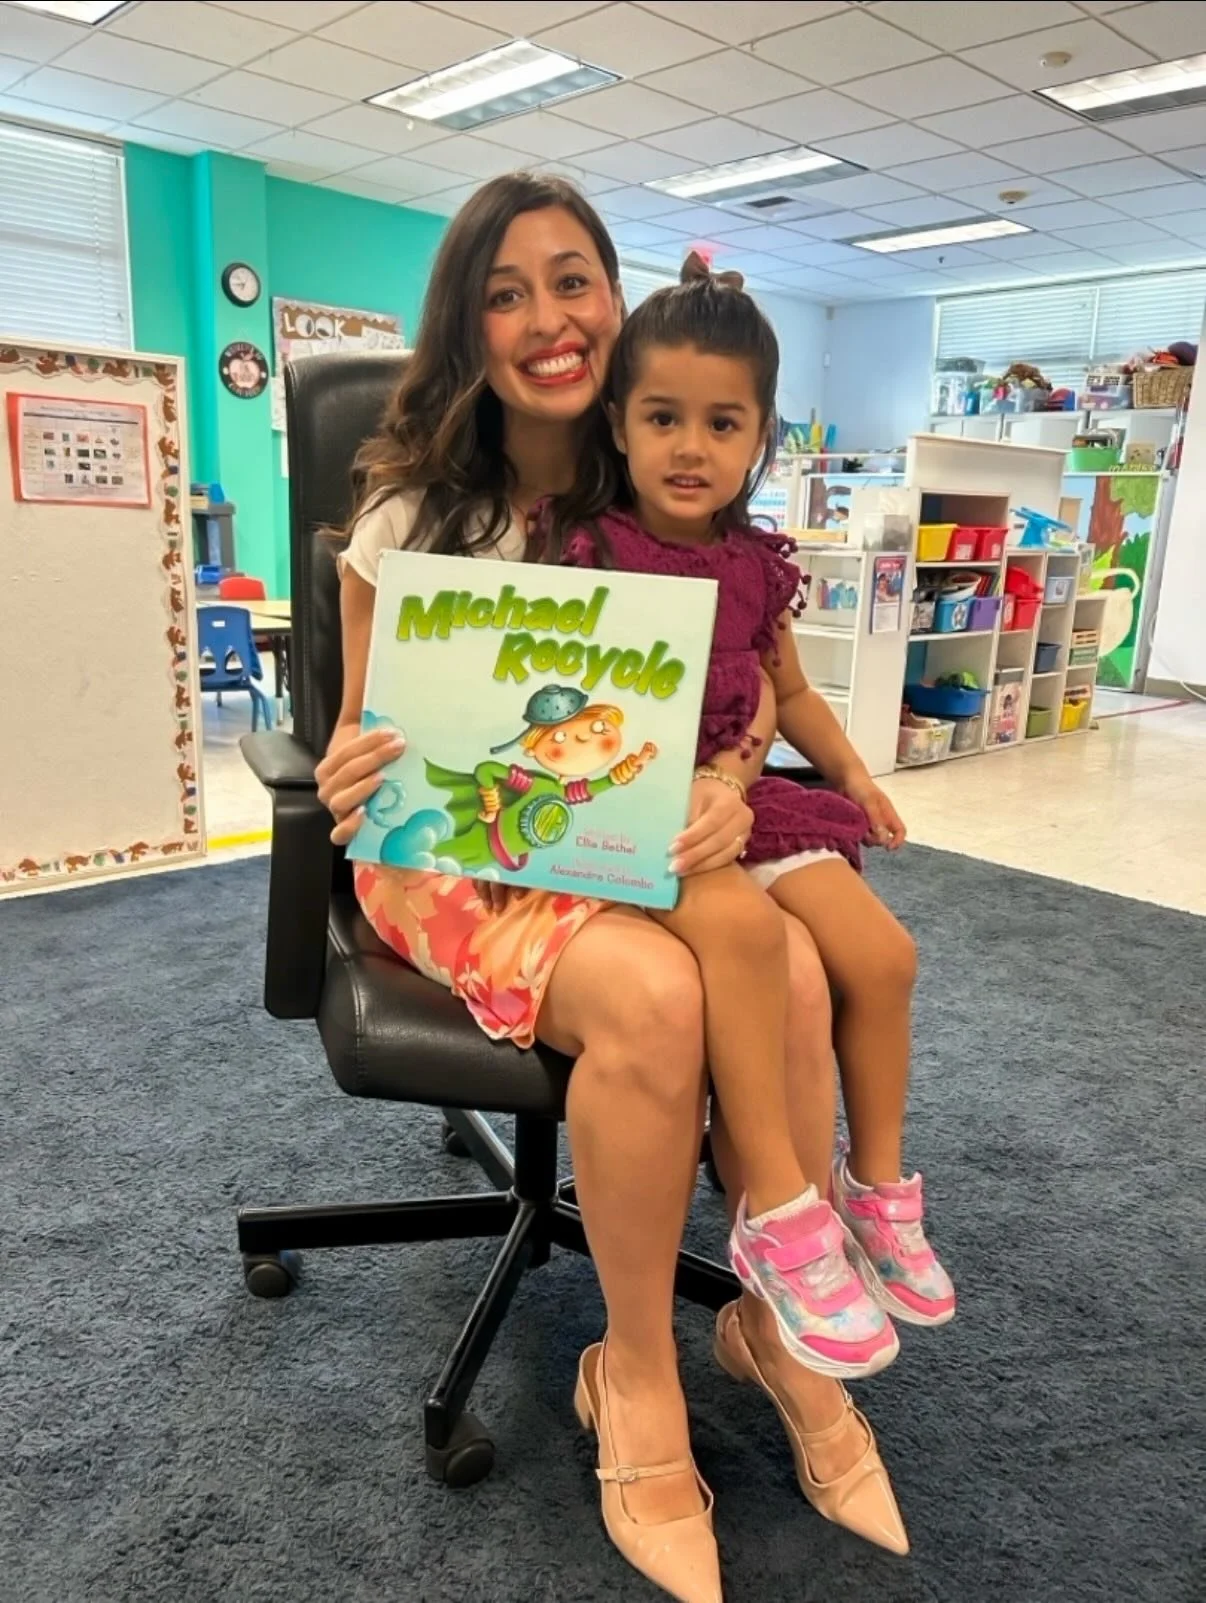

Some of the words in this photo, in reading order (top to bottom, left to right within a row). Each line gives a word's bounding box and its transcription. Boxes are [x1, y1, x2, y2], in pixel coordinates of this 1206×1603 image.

[285, 313, 346, 339] LOOK
[397, 585, 609, 640] Michael
[493, 632, 685, 699] Recycle
